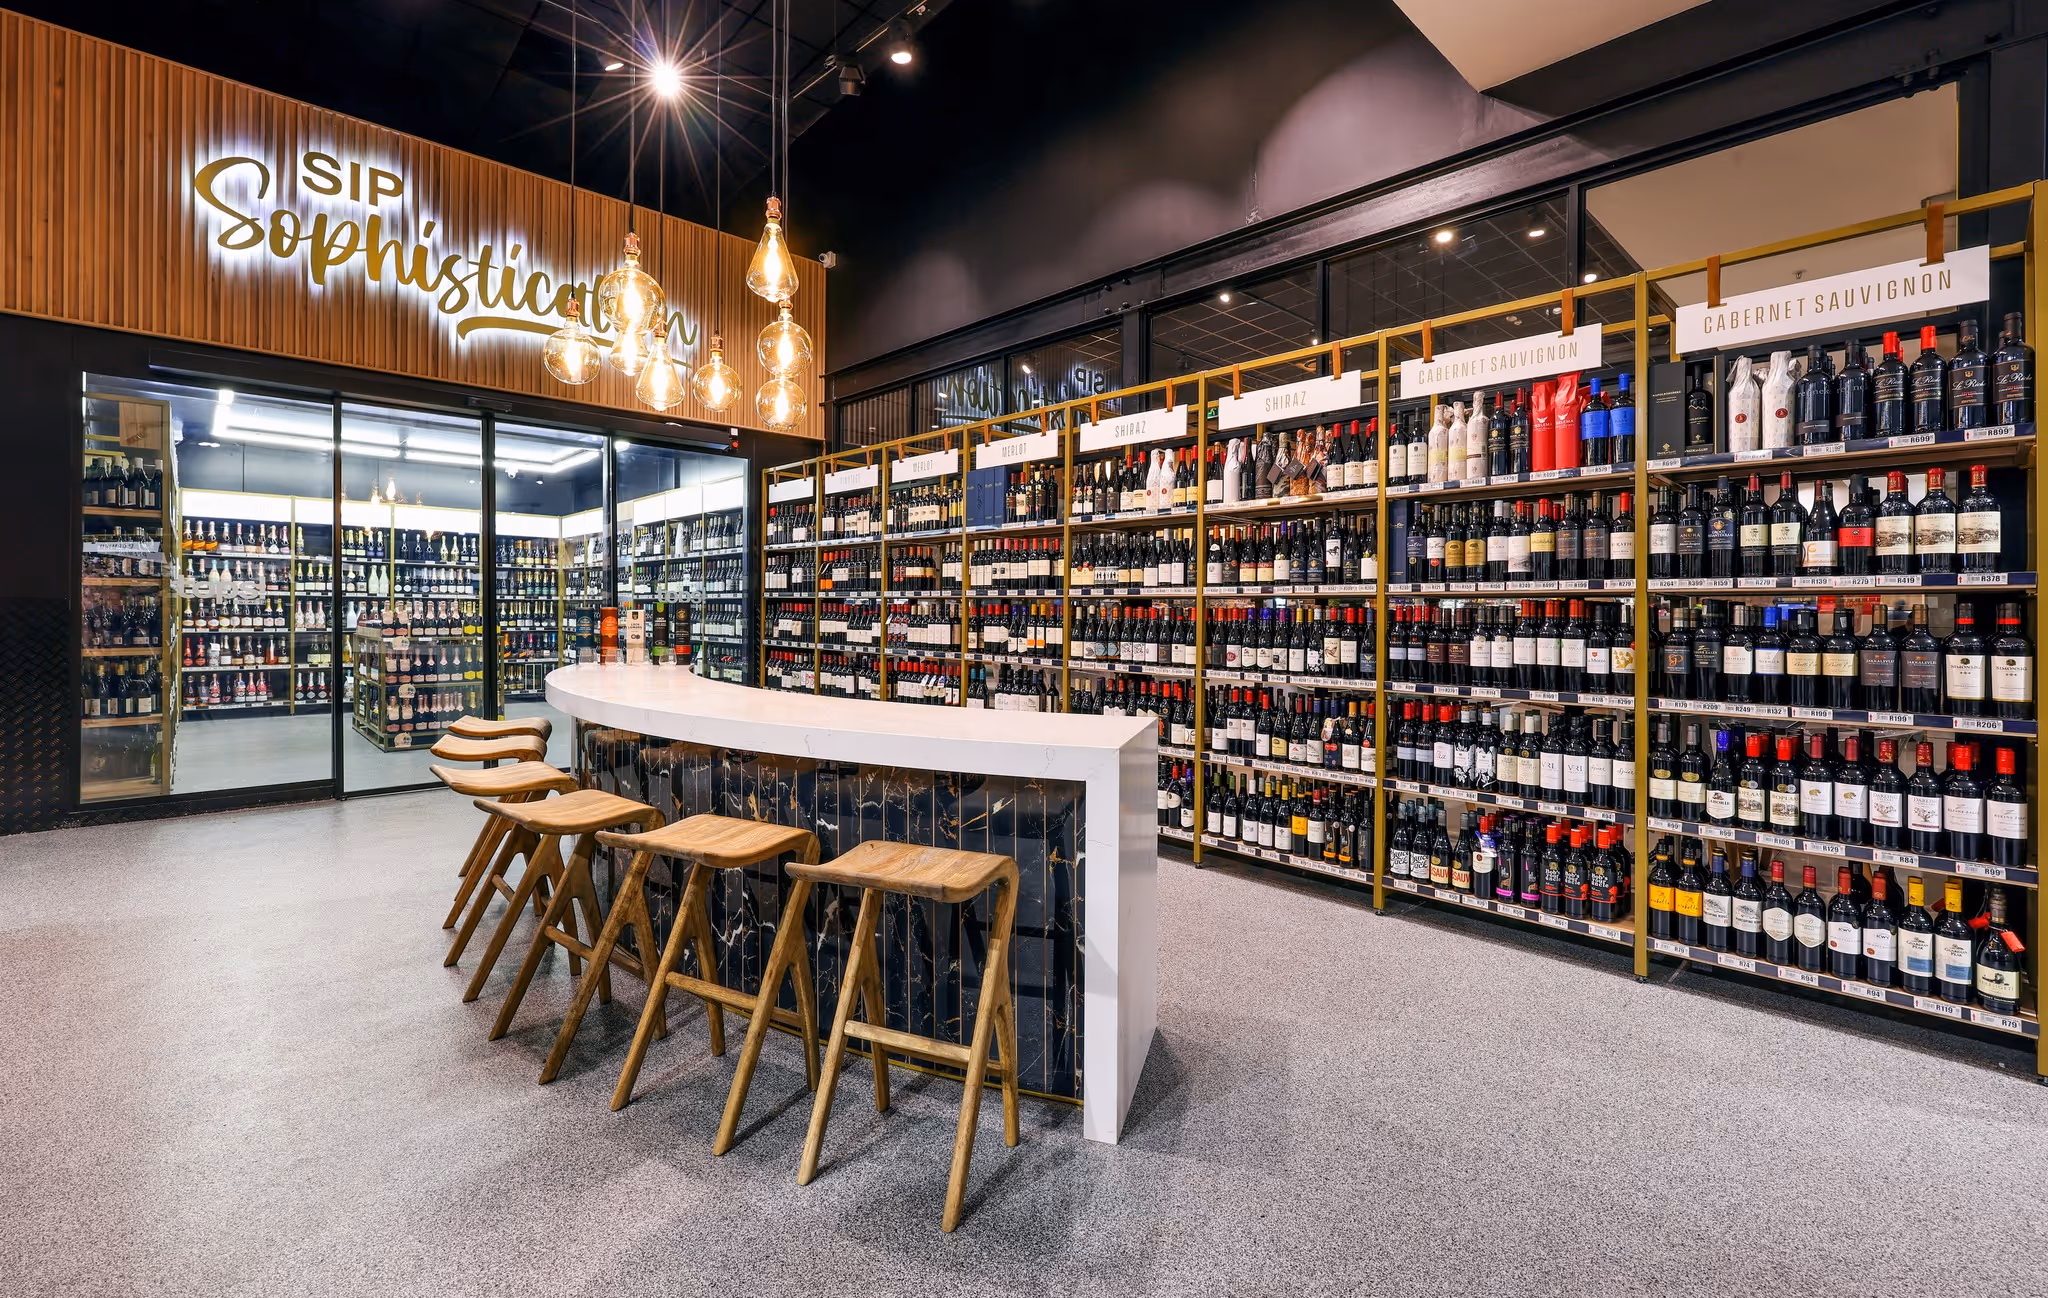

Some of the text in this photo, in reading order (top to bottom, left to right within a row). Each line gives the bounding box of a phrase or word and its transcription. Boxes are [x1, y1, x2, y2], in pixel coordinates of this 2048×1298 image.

[302, 150, 404, 207] SIP
[194, 156, 698, 346] Sophisticatn
[1704, 269, 1952, 334] CABERNET SAUVIGNON
[1418, 341, 1578, 385] CABERNET SAUVIGNON
[1265, 391, 1307, 412] SHIRAZ
[1115, 421, 1147, 438] SHIRAZ
[1988, 428, 2009, 436] R899
[1001, 442, 1027, 458] MERLOT
[913, 459, 933, 473] MERLOT
